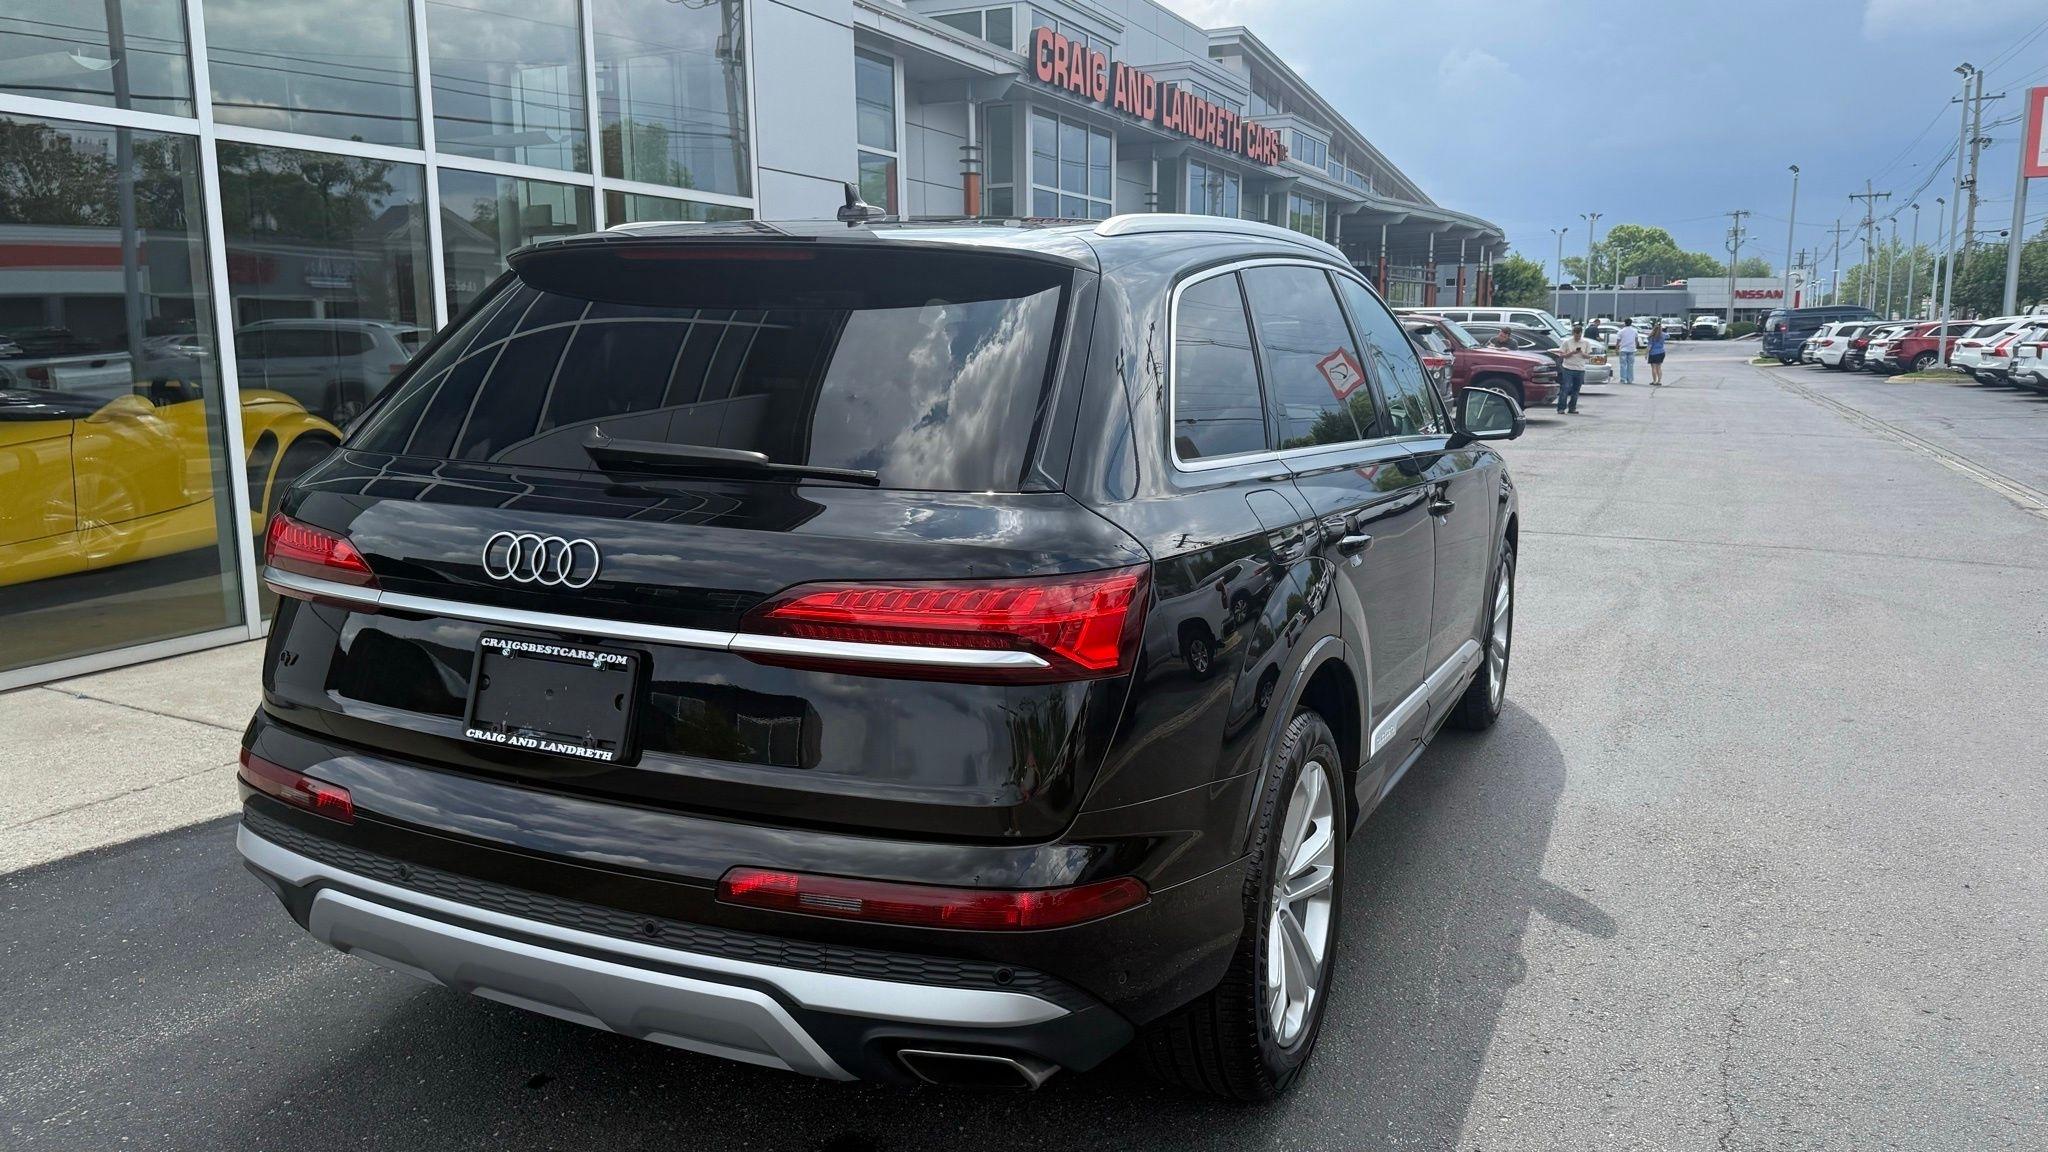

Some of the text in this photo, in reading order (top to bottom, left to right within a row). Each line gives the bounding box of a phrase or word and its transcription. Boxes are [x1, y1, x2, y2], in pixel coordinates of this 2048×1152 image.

[1034, 26, 1279, 166] CRAIG AND LANDRETH CARS
[1735, 289, 1783, 299] NISSAN
[481, 637, 628, 665] CRAIGSBESTCARS.COM
[466, 729, 613, 762] CRAIG AND LANDRETH
